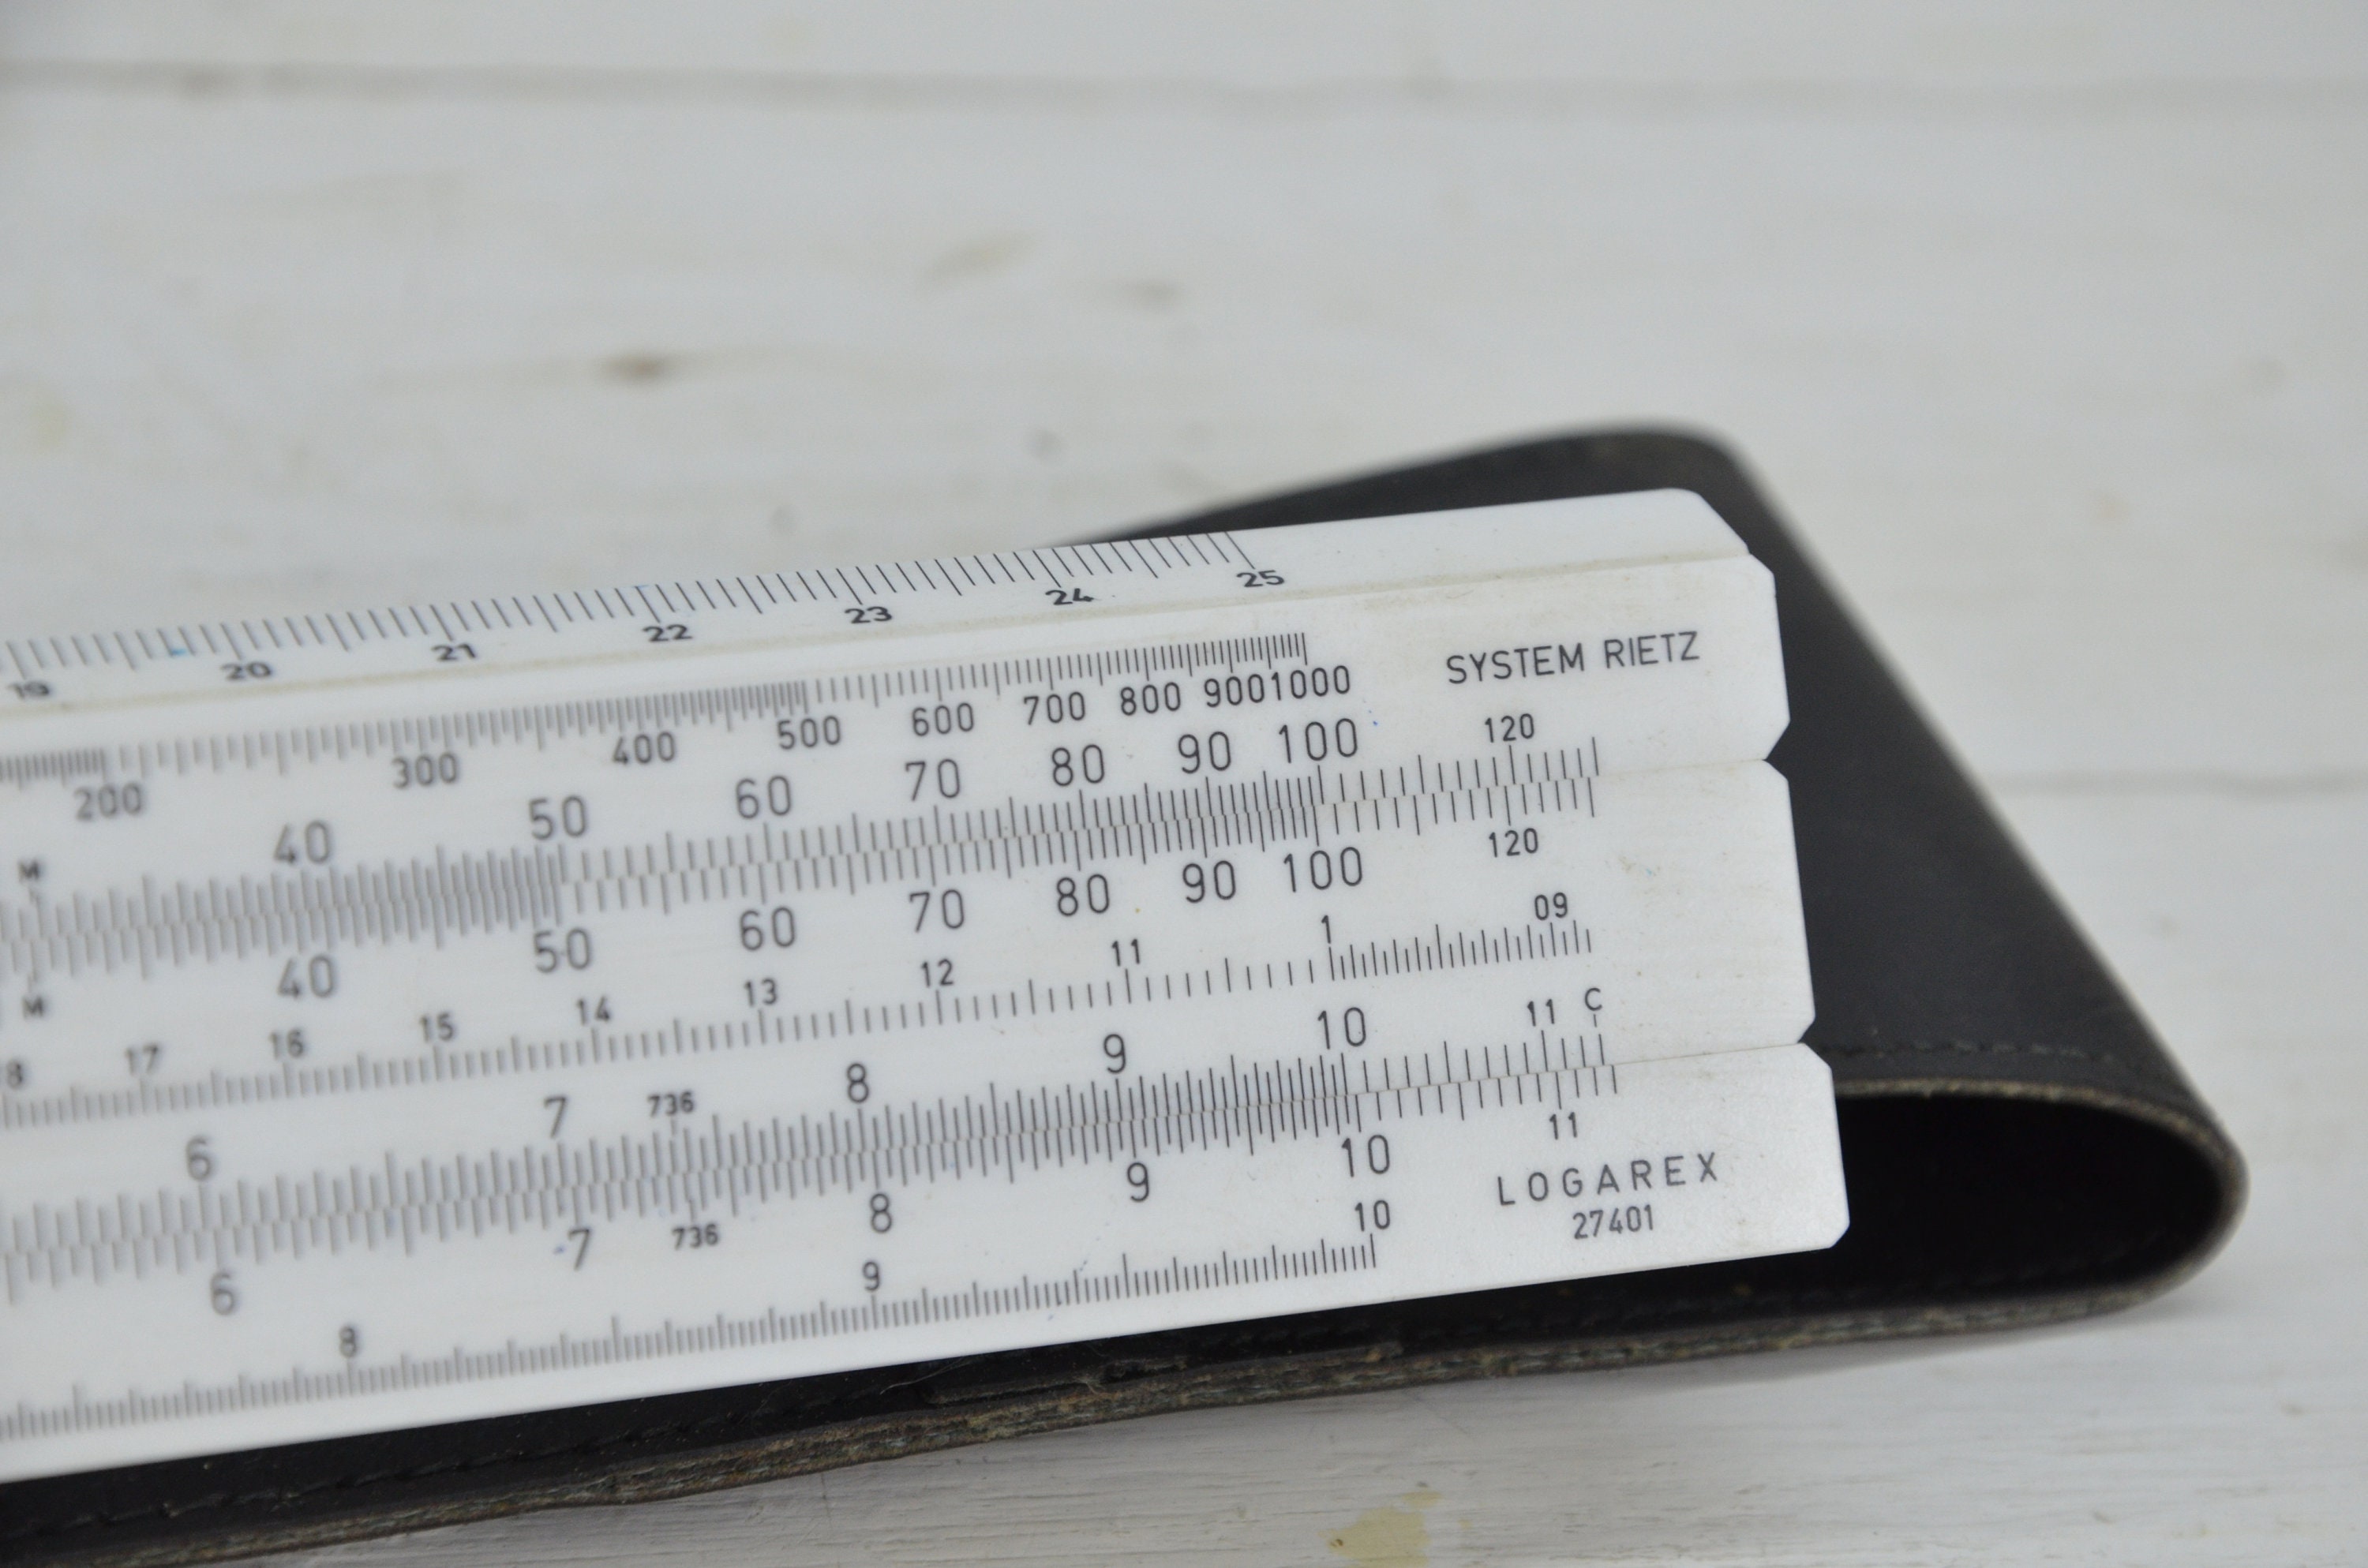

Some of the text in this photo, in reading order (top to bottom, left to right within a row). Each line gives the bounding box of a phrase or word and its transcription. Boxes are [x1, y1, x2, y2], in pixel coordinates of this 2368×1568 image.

[7, 570, 1284, 700] 19 20 21 22 23 24 25
[1447, 631, 1700, 684] SYSTEM RIETZ
[75, 665, 1350, 821] 200 300 400 500 600 700 800 900 1000
[272, 713, 1534, 865] 40 50 60 70 80 90 100 120
[18, 859, 41, 882] M
[277, 829, 1538, 999] 40 50 60 70 80 90 100 120
[23, 997, 46, 1019] M
[124, 1042, 161, 1076] 17
[269, 1030, 306, 1060] 16
[419, 1012, 455, 1043] 15
[577, 996, 612, 1025] 14
[744, 979, 778, 1008] 13
[921, 959, 954, 988] 12
[1111, 939, 1140, 966] 11
[1321, 915, 1331, 944] 1
[1534, 893, 1568, 921] 09
[185, 989, 1603, 1181] 6 7 736 8 9 10 11 C
[210, 1113, 1578, 1315] 6 7 736 8 9 10 11
[1498, 1152, 1719, 1207] LOGAREX
[1573, 1205, 1654, 1239] 27401
[340, 1200, 1391, 1359] 8 9 10
